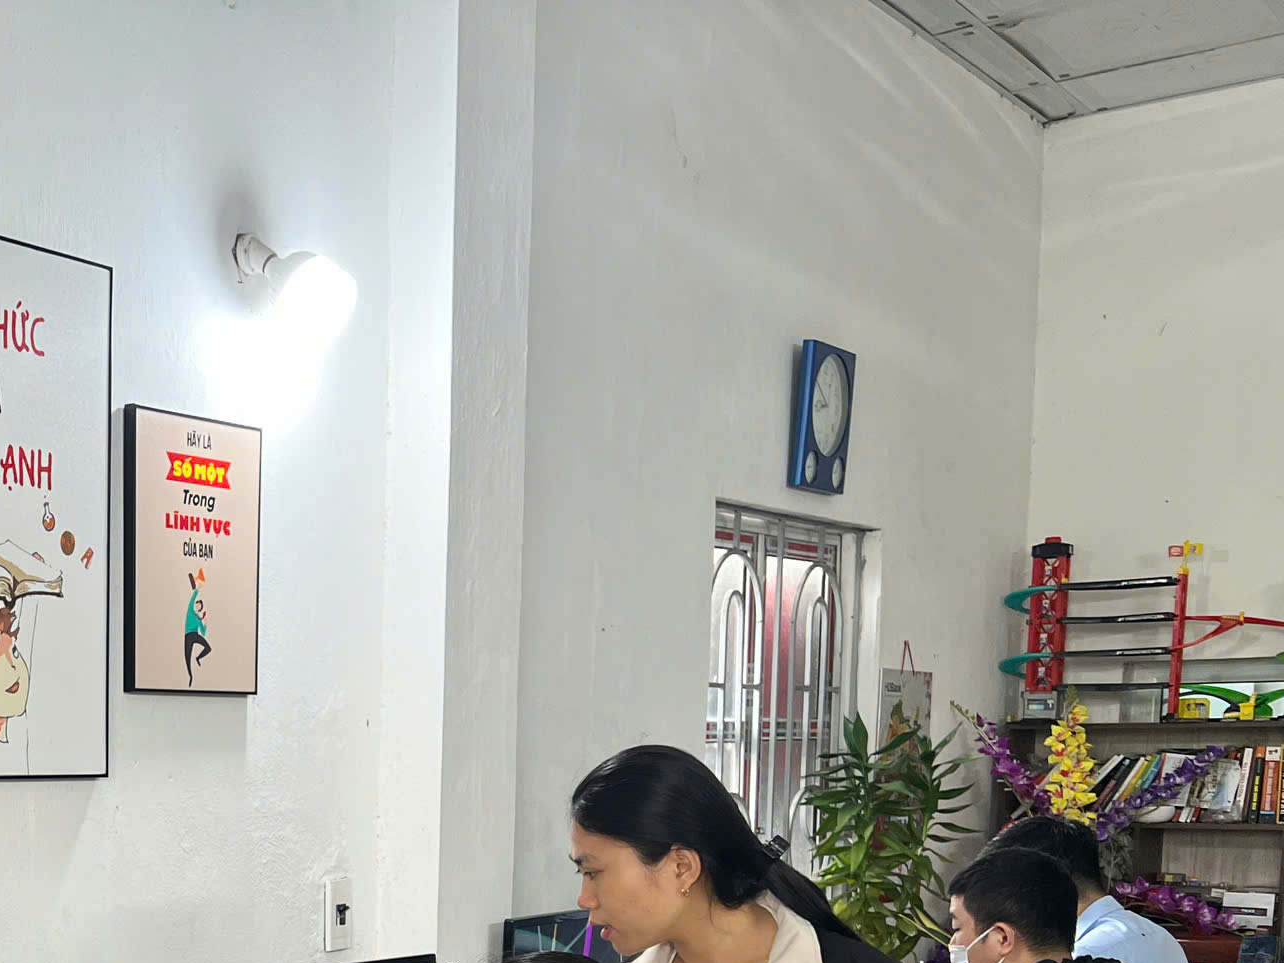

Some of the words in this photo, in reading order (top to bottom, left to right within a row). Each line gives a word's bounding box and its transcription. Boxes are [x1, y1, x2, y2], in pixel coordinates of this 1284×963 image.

[187, 430, 201, 448] HÃY
[202, 434, 212, 450] LÀ
[173, 455, 193, 480] SỐ
[194, 463, 226, 485] MỘT
[183, 489, 216, 512] Trong
[165, 510, 200, 533] LĨNH
[202, 518, 231, 538] VỰC
[183, 537, 198, 559] CỦA
[199, 542, 213, 562] BẠN
